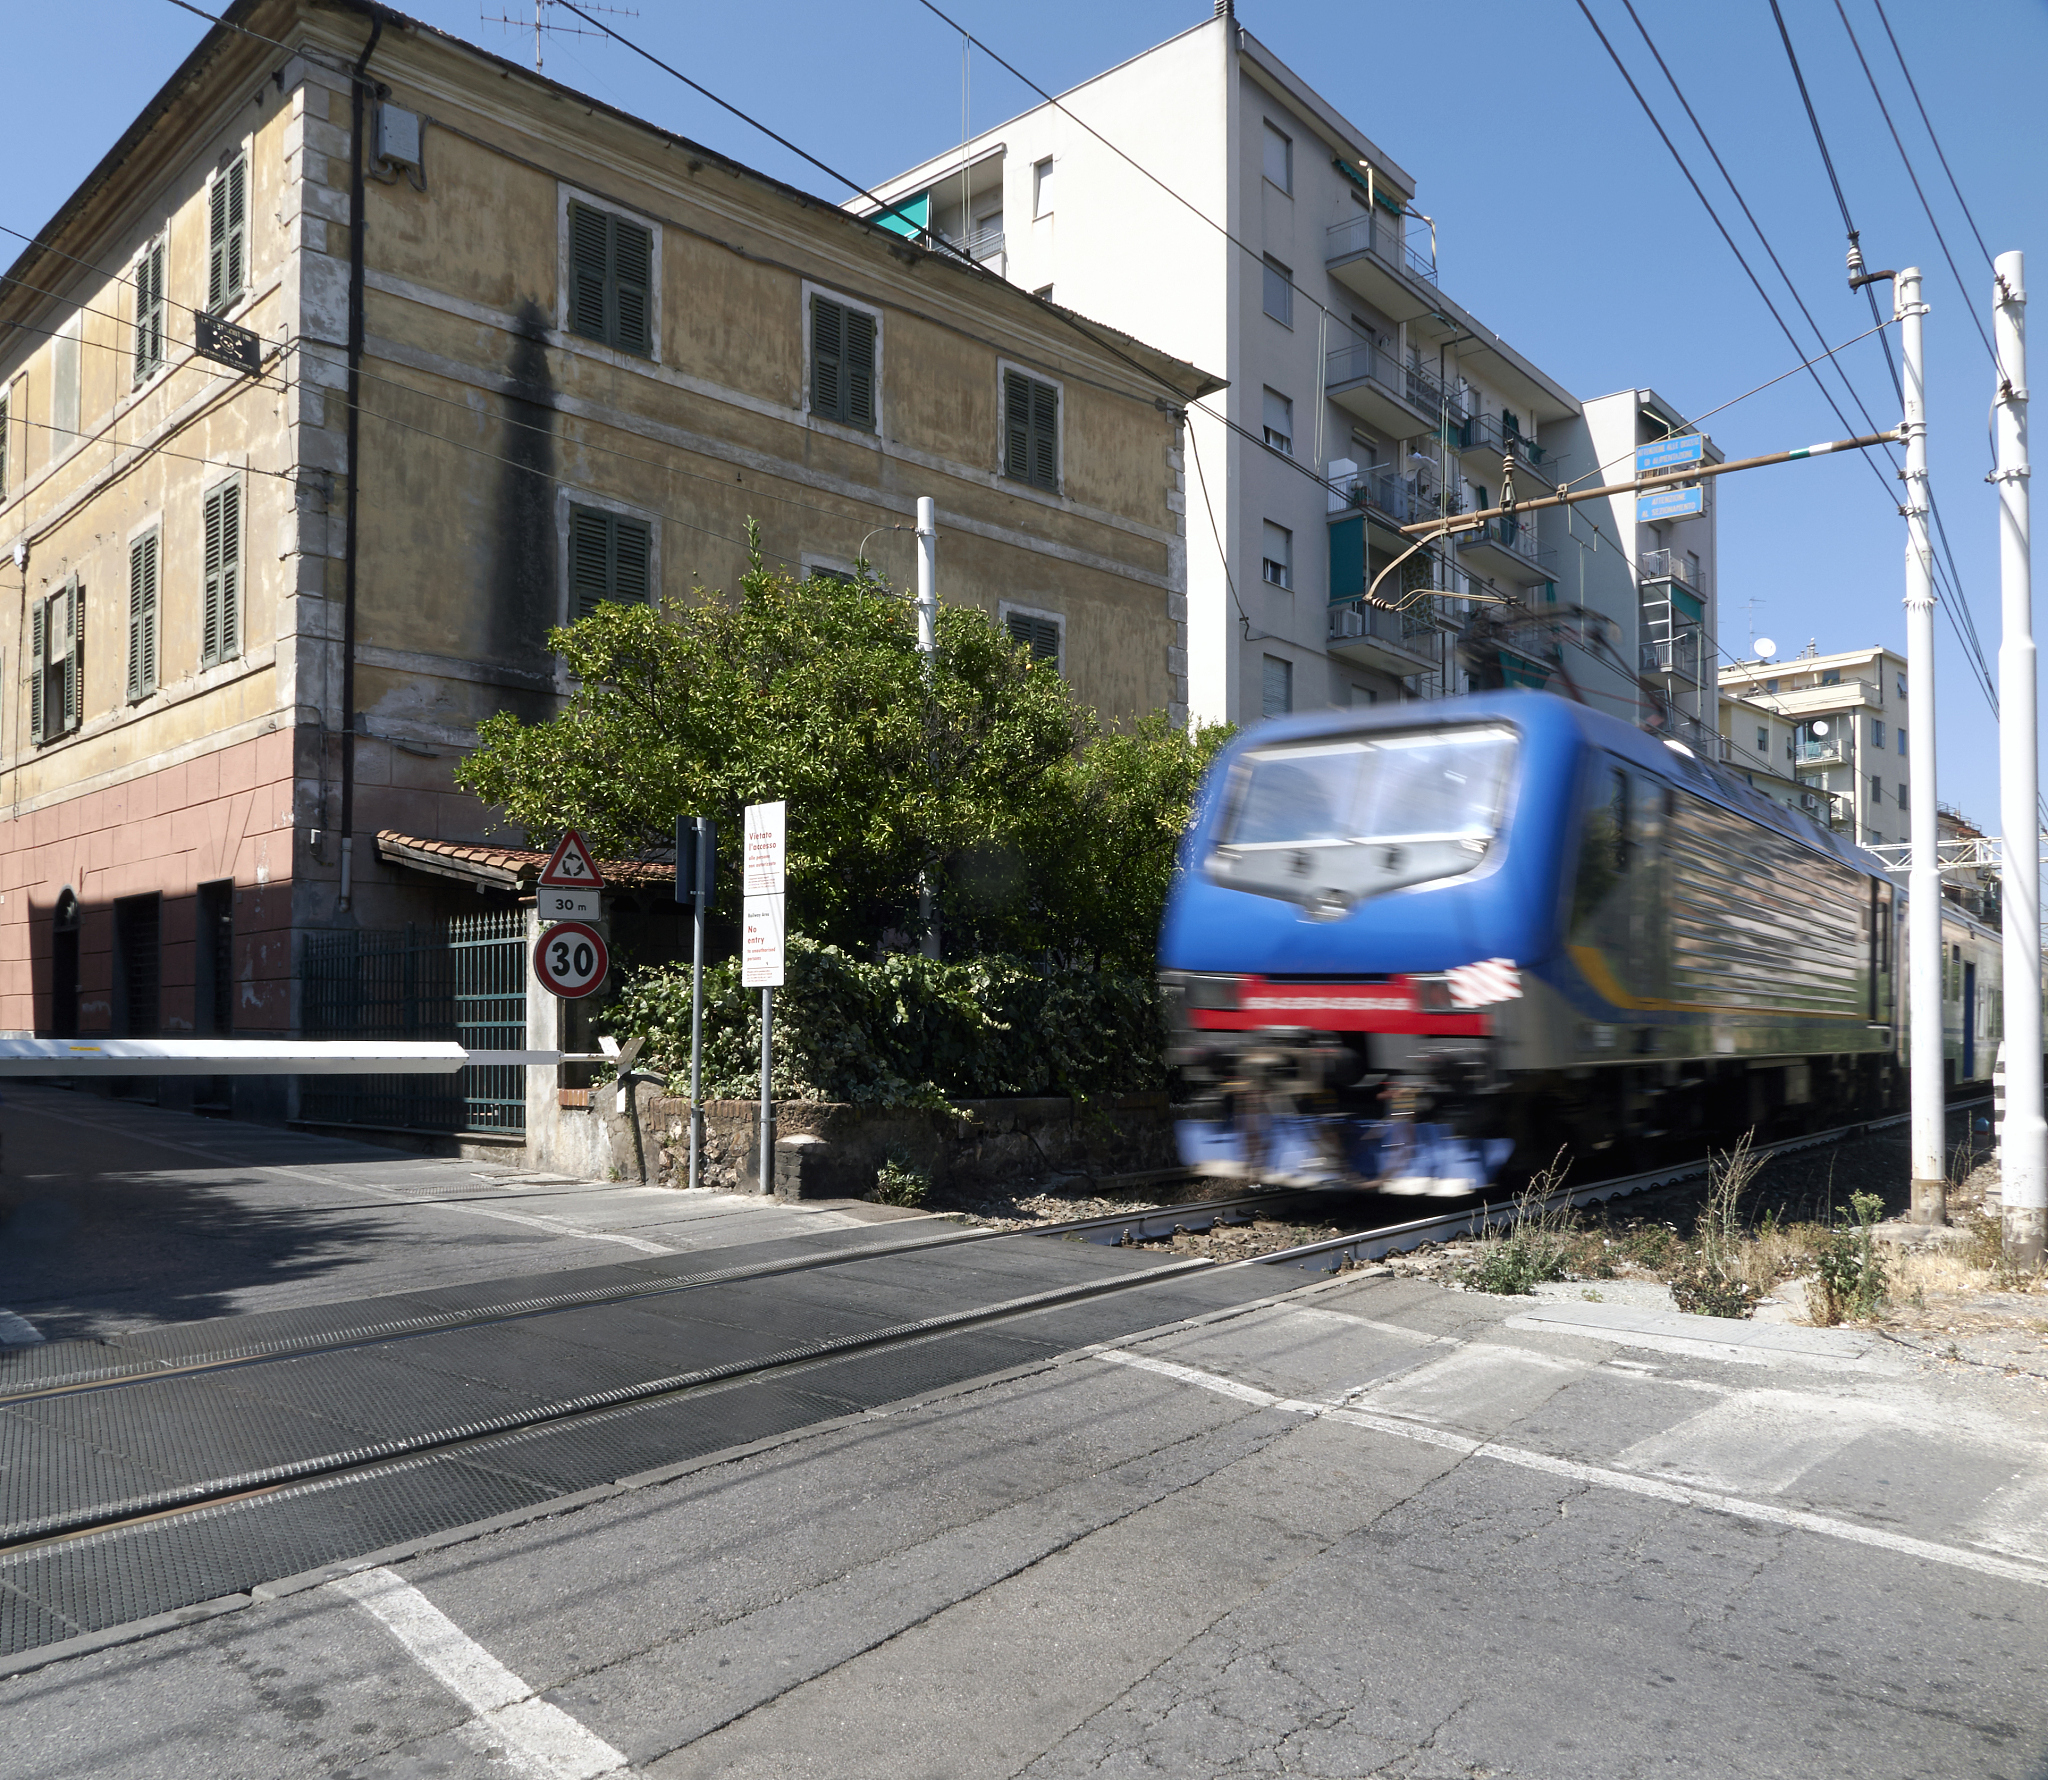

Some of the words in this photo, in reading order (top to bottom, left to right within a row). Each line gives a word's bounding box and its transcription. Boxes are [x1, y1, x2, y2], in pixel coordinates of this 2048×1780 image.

[1651, 493, 1686, 505] ATTENZIONE
[1651, 502, 1695, 516] SEZIONAMENTO
[749, 832, 772, 840] Vietato
[749, 842, 776, 851] l'accesso
[555, 899, 574, 910] 30
[577, 903, 587, 911] m
[748, 937, 764, 945] entry
[551, 941, 594, 977] 30
